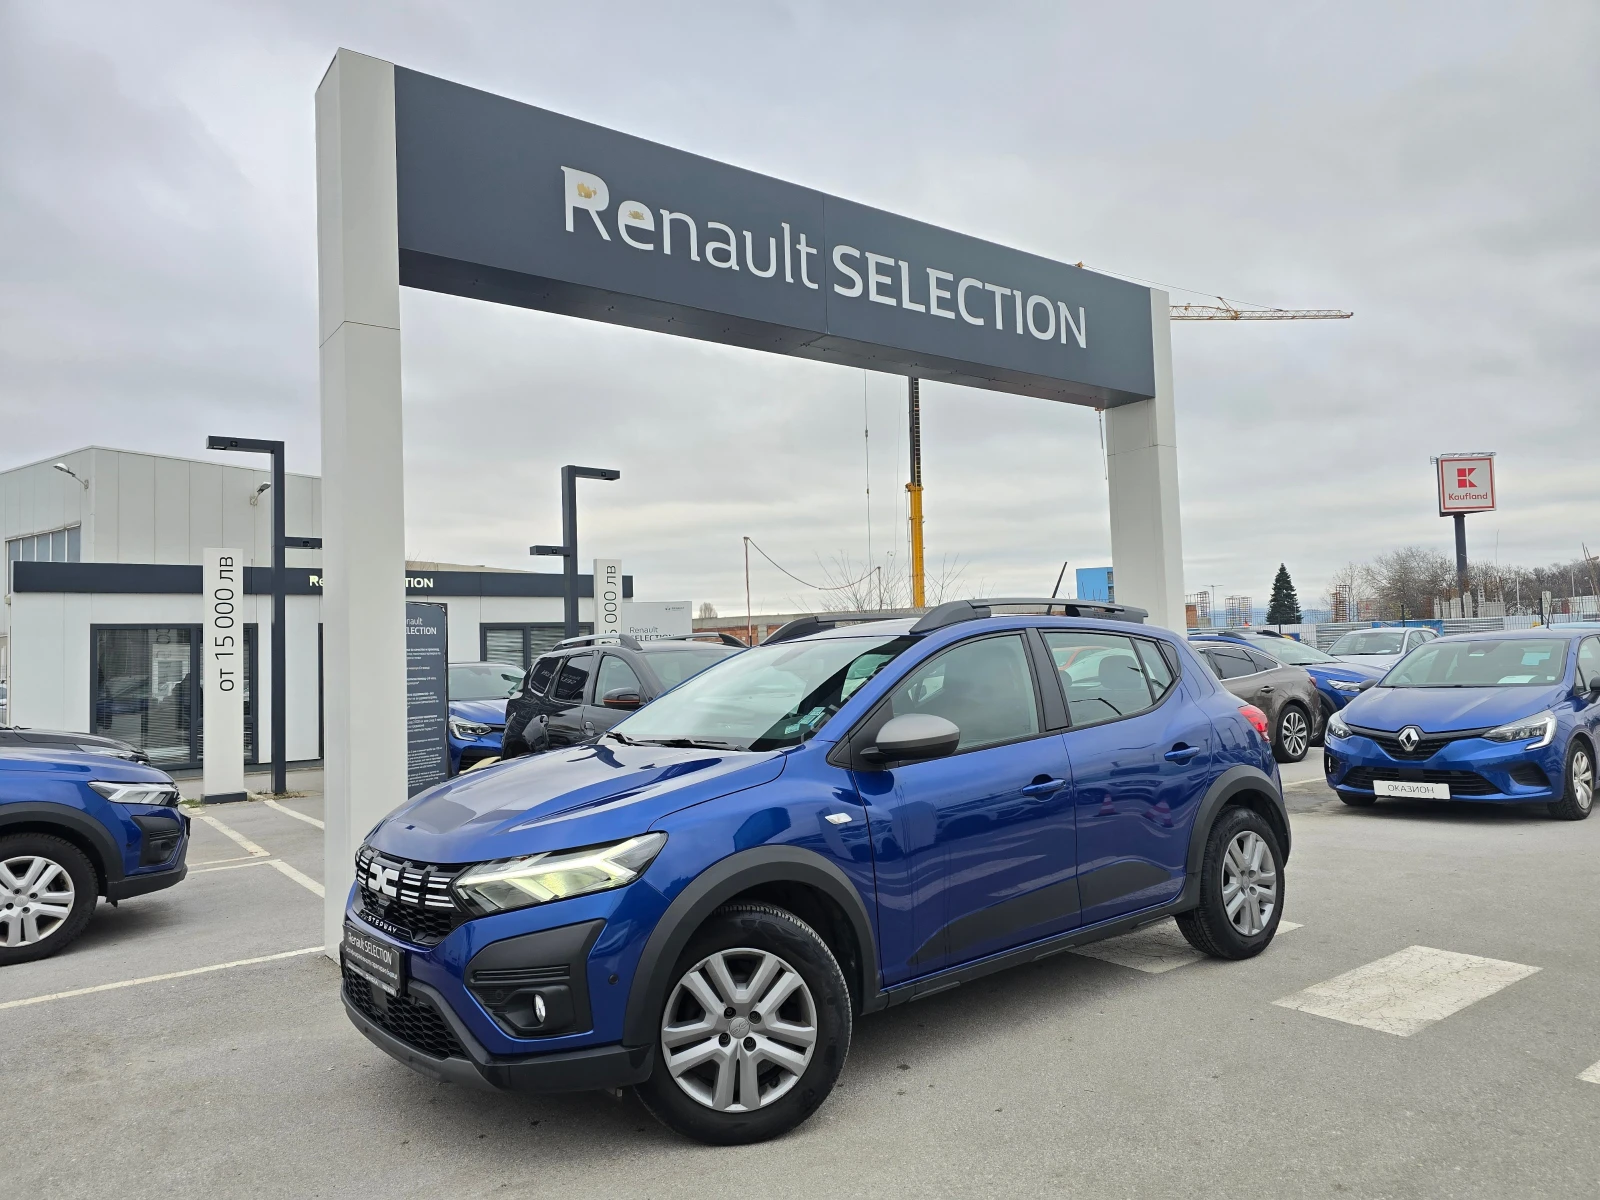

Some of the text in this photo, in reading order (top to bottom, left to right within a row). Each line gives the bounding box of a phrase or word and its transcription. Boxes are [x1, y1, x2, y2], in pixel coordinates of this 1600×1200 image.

[560, 165, 1088, 350] Renault SELECTION
[1448, 492, 1488, 501] Kaufland
[214, 588, 235, 629] 000
[603, 591, 618, 623] 000
[406, 616, 423, 626] nault
[629, 625, 659, 634] Renault
[214, 635, 235, 660] 15
[1387, 784, 1435, 794] ОКАЗИОН
[368, 915, 398, 933] STEPWAY
[364, 940, 393, 966] SELECTION
